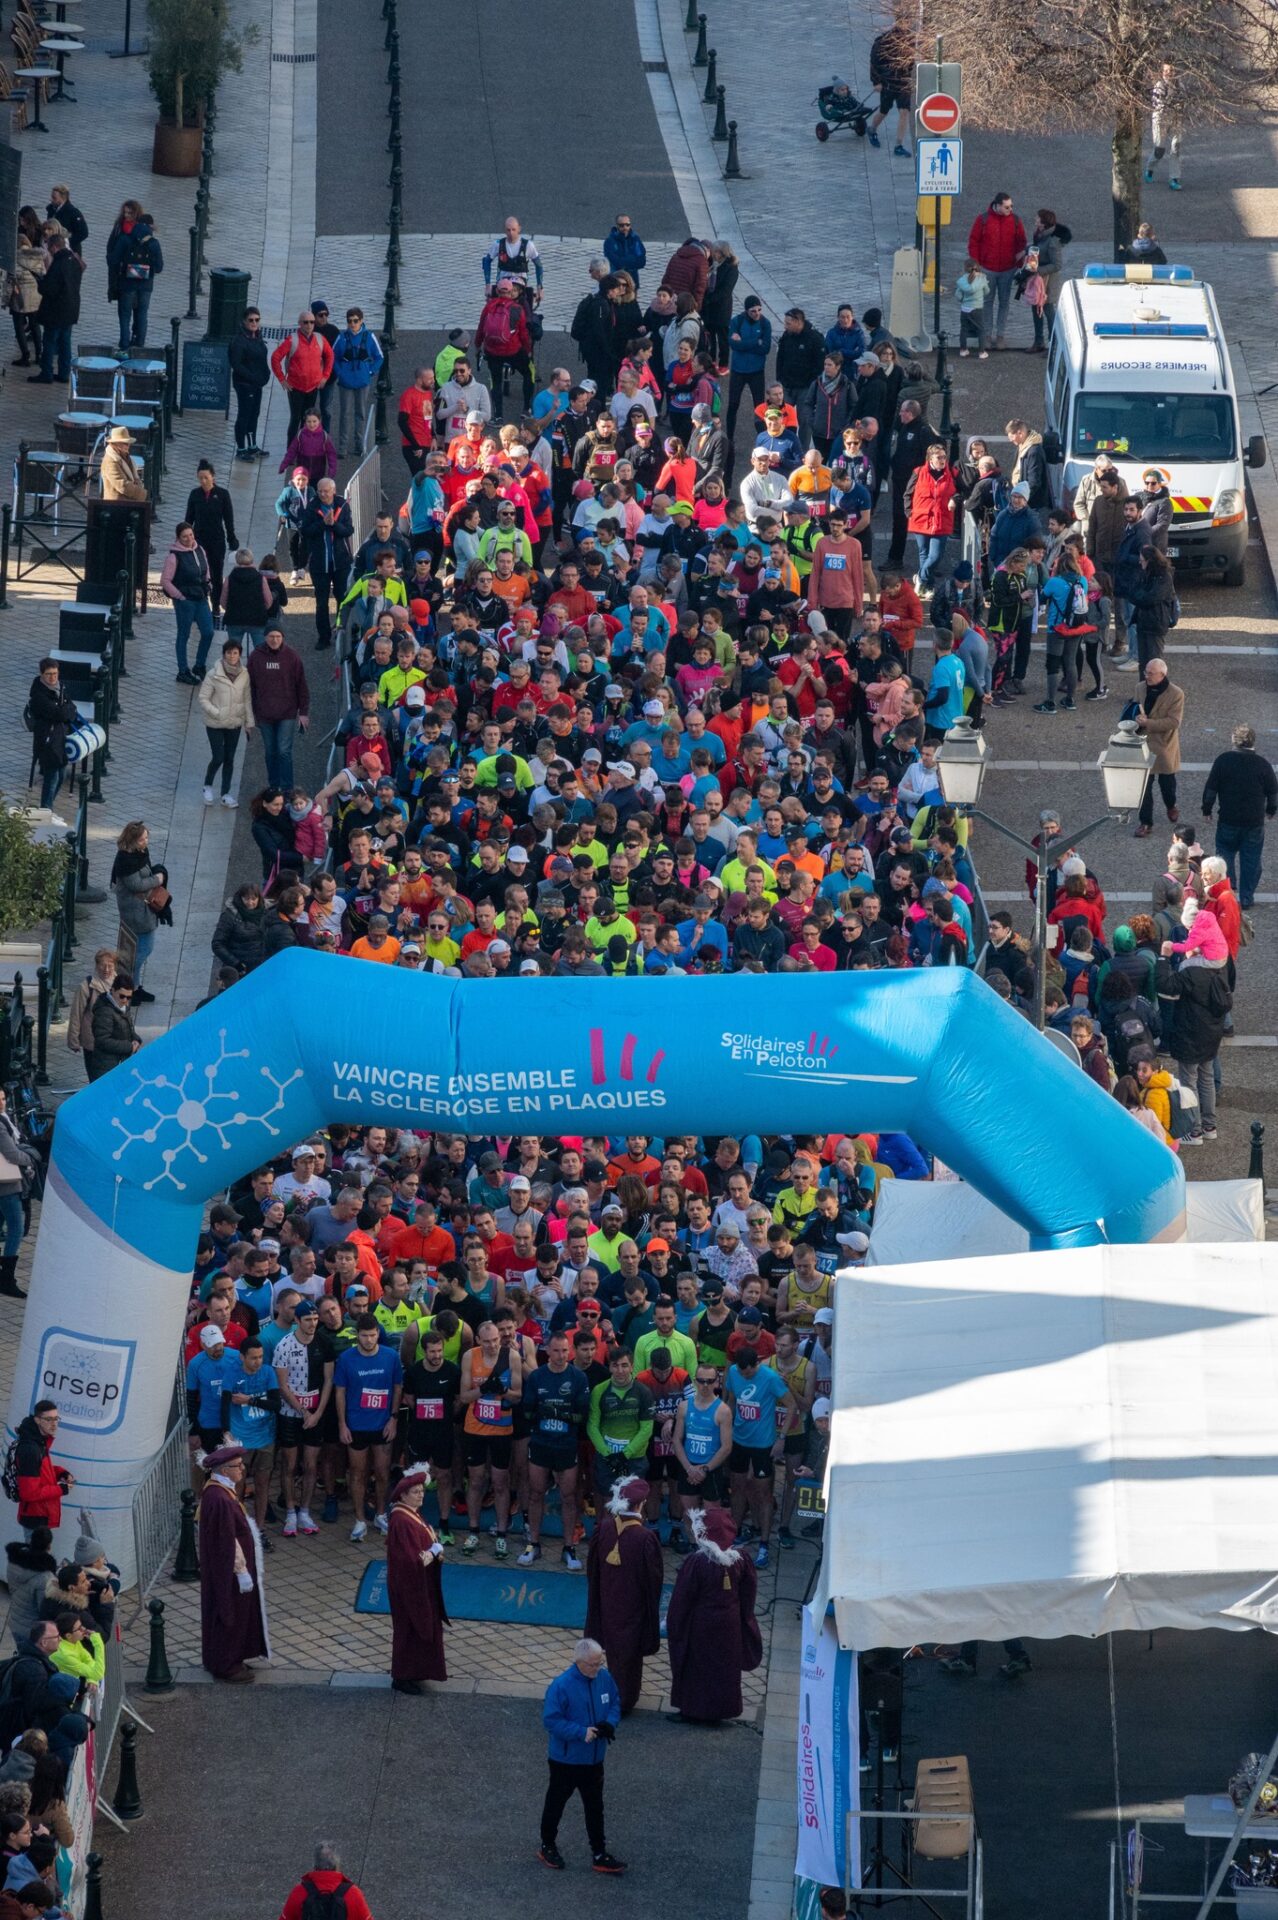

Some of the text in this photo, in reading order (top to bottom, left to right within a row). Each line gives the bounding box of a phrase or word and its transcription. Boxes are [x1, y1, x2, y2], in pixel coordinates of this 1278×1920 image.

[827, 558, 842, 568] 495
[721, 1032, 805, 1053] Solidaires
[731, 1045, 826, 1069] En Peloton
[333, 1061, 576, 1096] VAINCRE ENSEMBLE
[333, 1084, 667, 1117] LA SCLEROSE EN PLAQUES
[43, 1370, 119, 1406] arsep
[367, 1395, 382, 1408] 161
[423, 1405, 435, 1418] 75
[479, 1404, 495, 1419] 188
[740, 1405, 756, 1419] 200
[690, 1441, 706, 1454] 376
[801, 1722, 819, 1829] Solidaires
